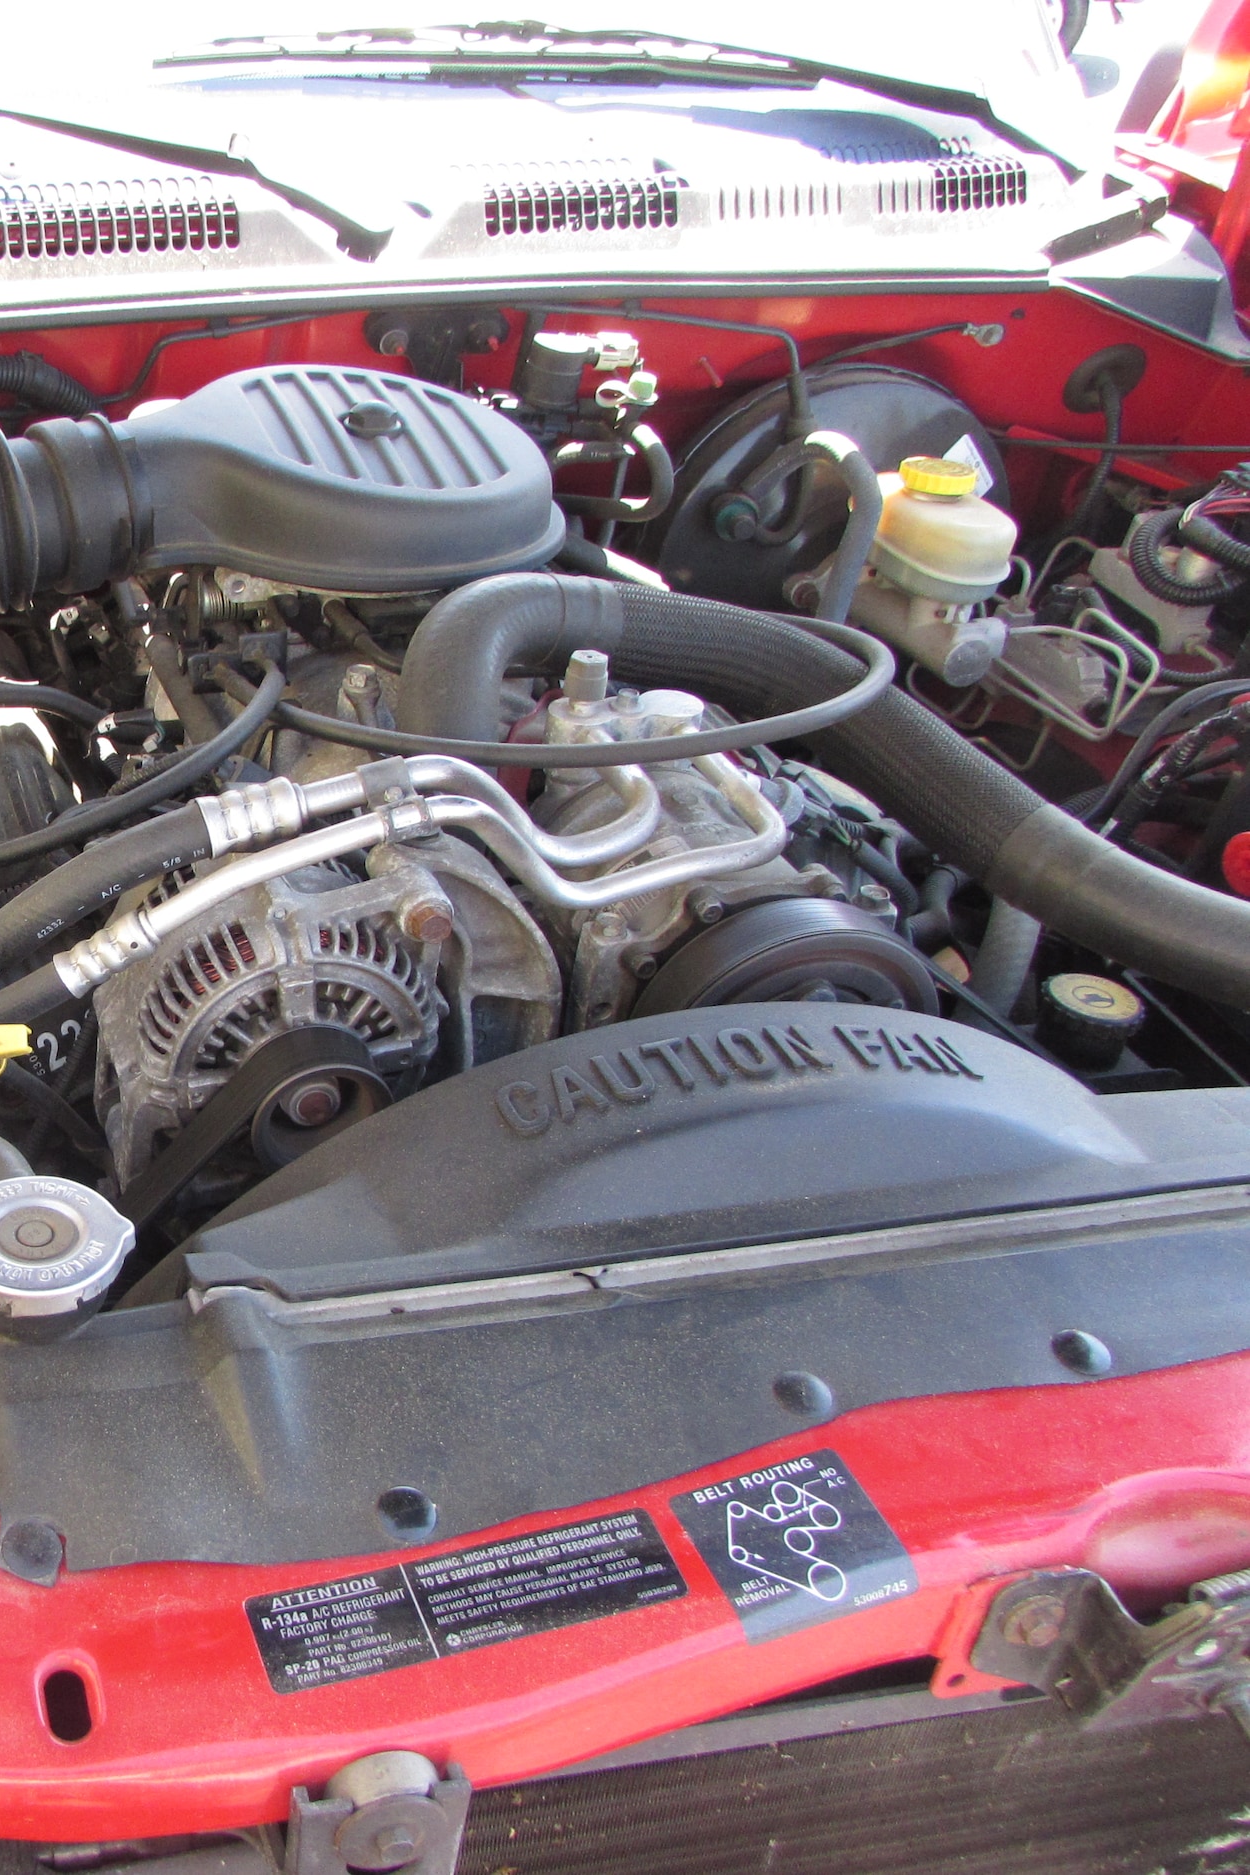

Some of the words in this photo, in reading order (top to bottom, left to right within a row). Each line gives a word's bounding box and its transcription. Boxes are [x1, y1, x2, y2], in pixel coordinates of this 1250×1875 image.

[101, 883, 122, 899] A/C
[162, 856, 182, 869] 5/8
[193, 848, 205, 858] IN
[494, 1024, 834, 1137] CAUTION
[834, 1024, 985, 1080] FAN
[0, 1263, 33, 1280] NOT
[39, 1259, 85, 1282] OPEN
[692, 1481, 735, 1505] BELT
[739, 1457, 815, 1489] ROUTING
[819, 1467, 837, 1480] NO
[827, 1475, 846, 1489] A/C
[414, 1556, 462, 1576] WARNING:
[463, 1537, 537, 1564] HIGH-PRESSURE
[538, 1523, 600, 1546] REFRIGERANT
[601, 1514, 638, 1531] SYSTEM
[420, 1576, 435, 1588] TO
[436, 1573, 451, 1584] BE
[451, 1562, 496, 1581] SERVICED
[497, 1558, 510, 1570] BY
[511, 1546, 560, 1566] QUALIFIED
[560, 1535, 617, 1554] PERSONNEL
[616, 1526, 642, 1541] ONLY.
[427, 1587, 466, 1604] CONSULT
[468, 1578, 504, 1594] SERVICE
[504, 1569, 543, 1584] MANUAL.
[545, 1557, 590, 1574] IMPROPER
[590, 1548, 627, 1564] SERVICE
[432, 1596, 474, 1615] METHODS
[474, 1592, 494, 1604] MAY
[495, 1586, 524, 1599] CAUSE
[525, 1574, 569, 1592] PERSONAL
[569, 1566, 603, 1580] INJURY.
[605, 1557, 641, 1571] SYSTEM
[741, 1576, 771, 1592] BELT
[272, 1577, 377, 1609] ATTENTION
[436, 1611, 467, 1625] MEETS
[468, 1603, 498, 1618] SAFETY
[499, 1586, 567, 1610] REQUIREMENTS
[567, 1582, 579, 1593] OF
[579, 1578, 598, 1589] SAE
[598, 1567, 643, 1585] STANDARD
[734, 1583, 790, 1608] REMOVAL
[853, 1579, 908, 1608] 53008745
[261, 1611, 309, 1630] R-134a
[312, 1605, 330, 1618] A/C
[332, 1588, 405, 1614] REFRIGERANT
[280, 1620, 328, 1639] FACTORY
[331, 1610, 378, 1627] CHARGE:
[459, 1620, 505, 1637] CHRYSLER
[462, 1624, 524, 1644] CORPORATION
[304, 1633, 330, 1646] 0.907
[308, 1645, 331, 1657] PART
[285, 1659, 320, 1676] SP-20
[322, 1653, 346, 1667] PAG
[347, 1641, 407, 1662] COMPRESSOR
[407, 1637, 421, 1648] OIL
[297, 1672, 321, 1684] PART
